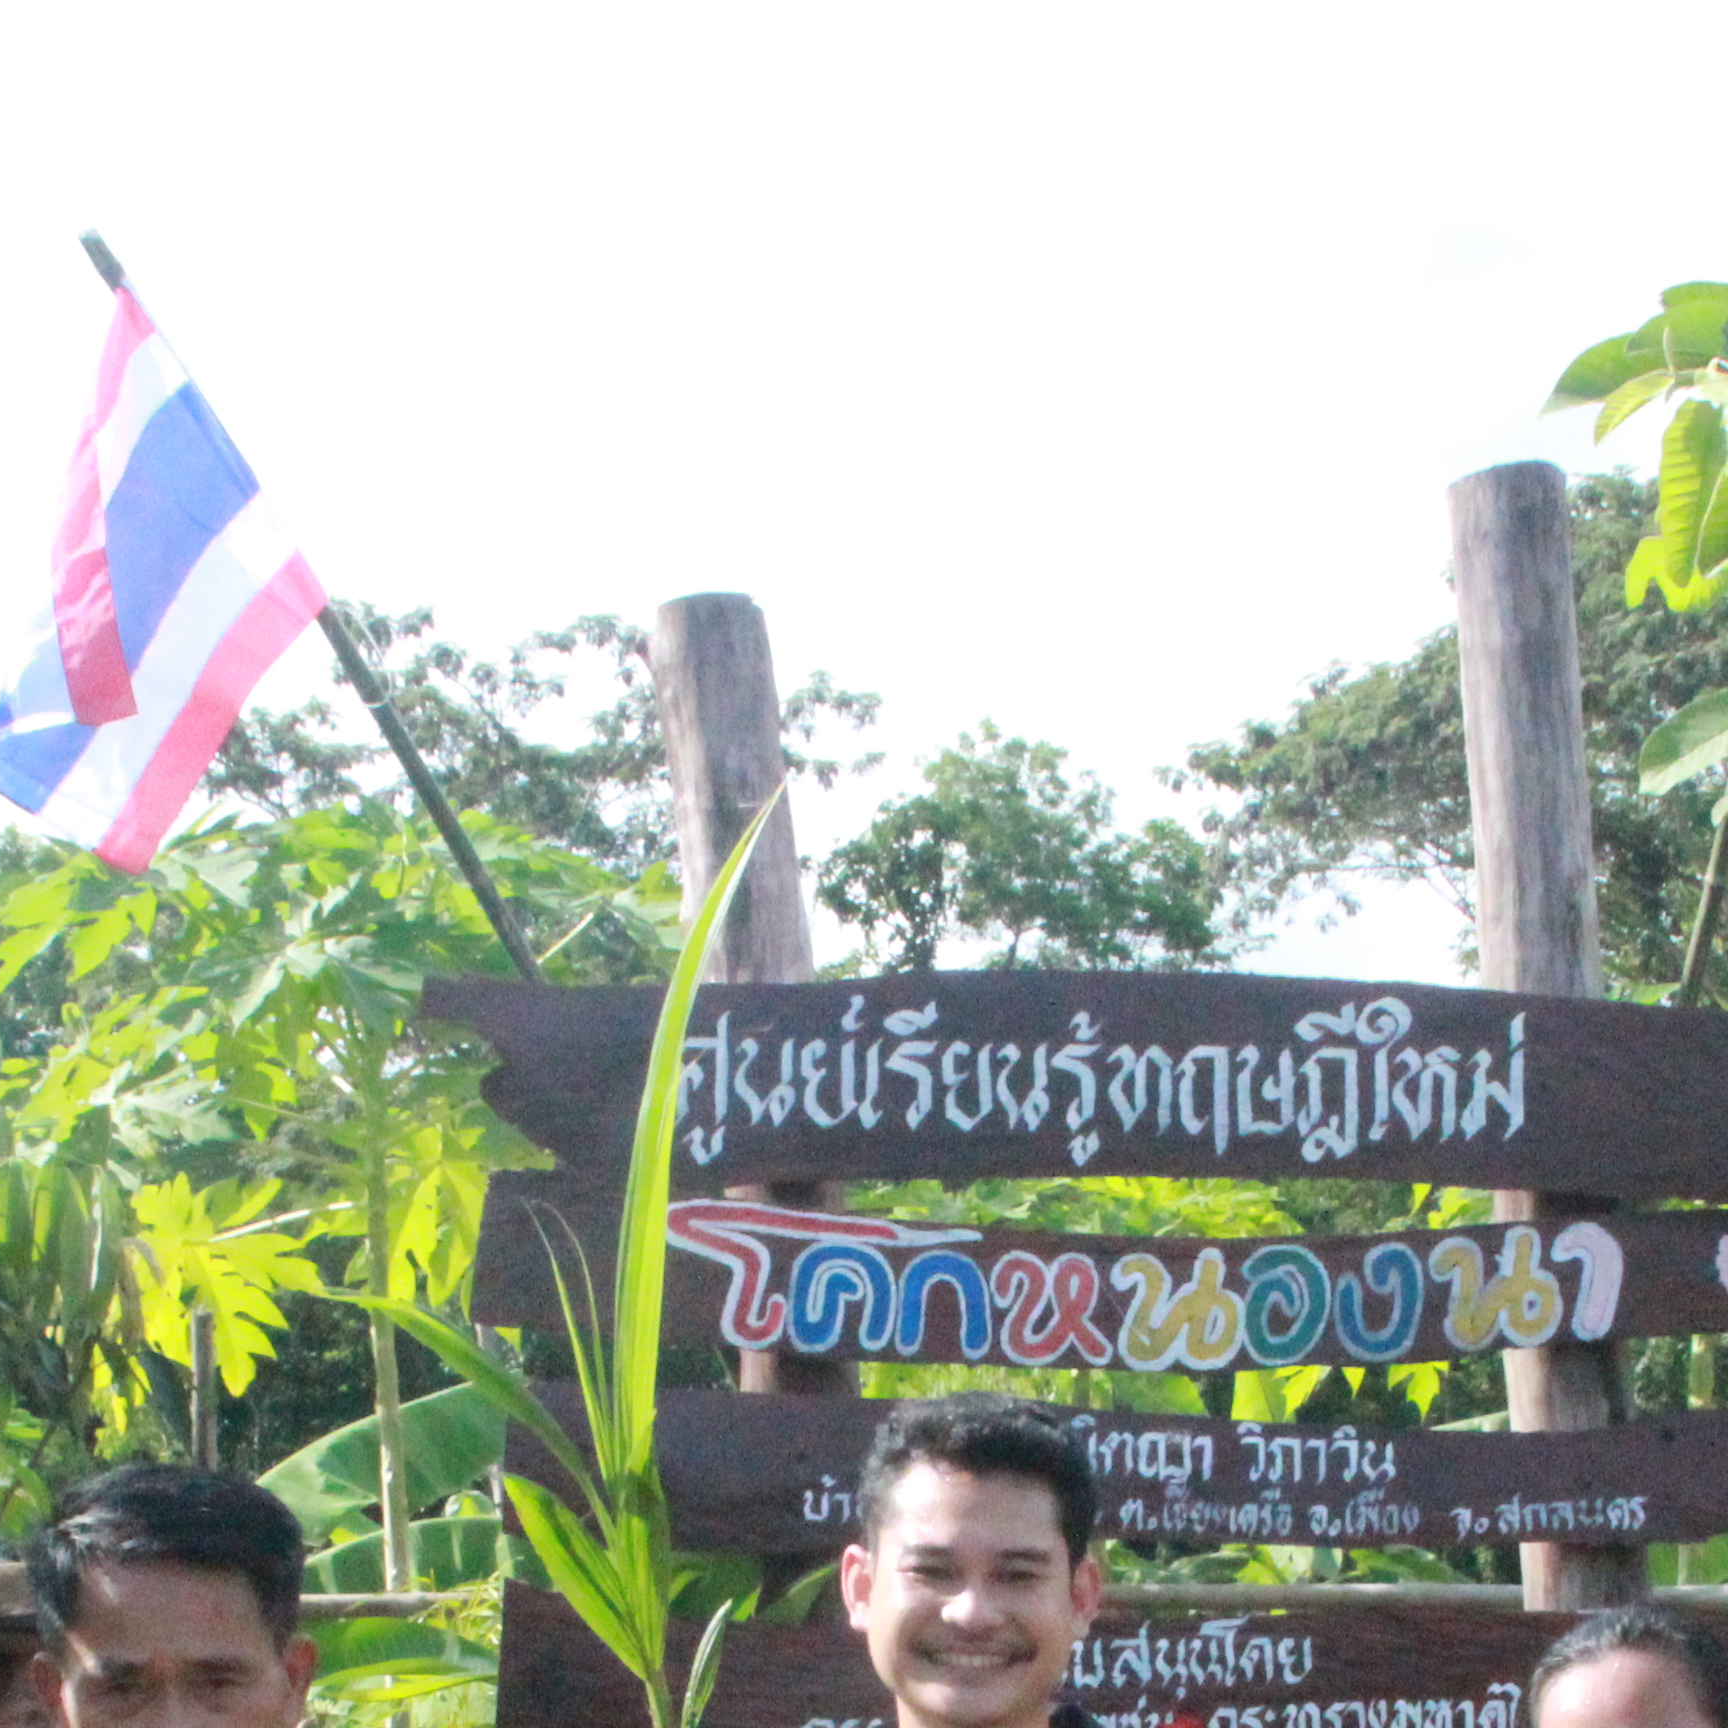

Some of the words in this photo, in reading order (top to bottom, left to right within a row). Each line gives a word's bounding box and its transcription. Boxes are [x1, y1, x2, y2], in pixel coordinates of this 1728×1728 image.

[666, 1202, 1624, 1373] โคกหนองนา
[802, 1473, 860, 1523] บ้า
[1060, 1614, 1313, 1700] บสนุนโดย
